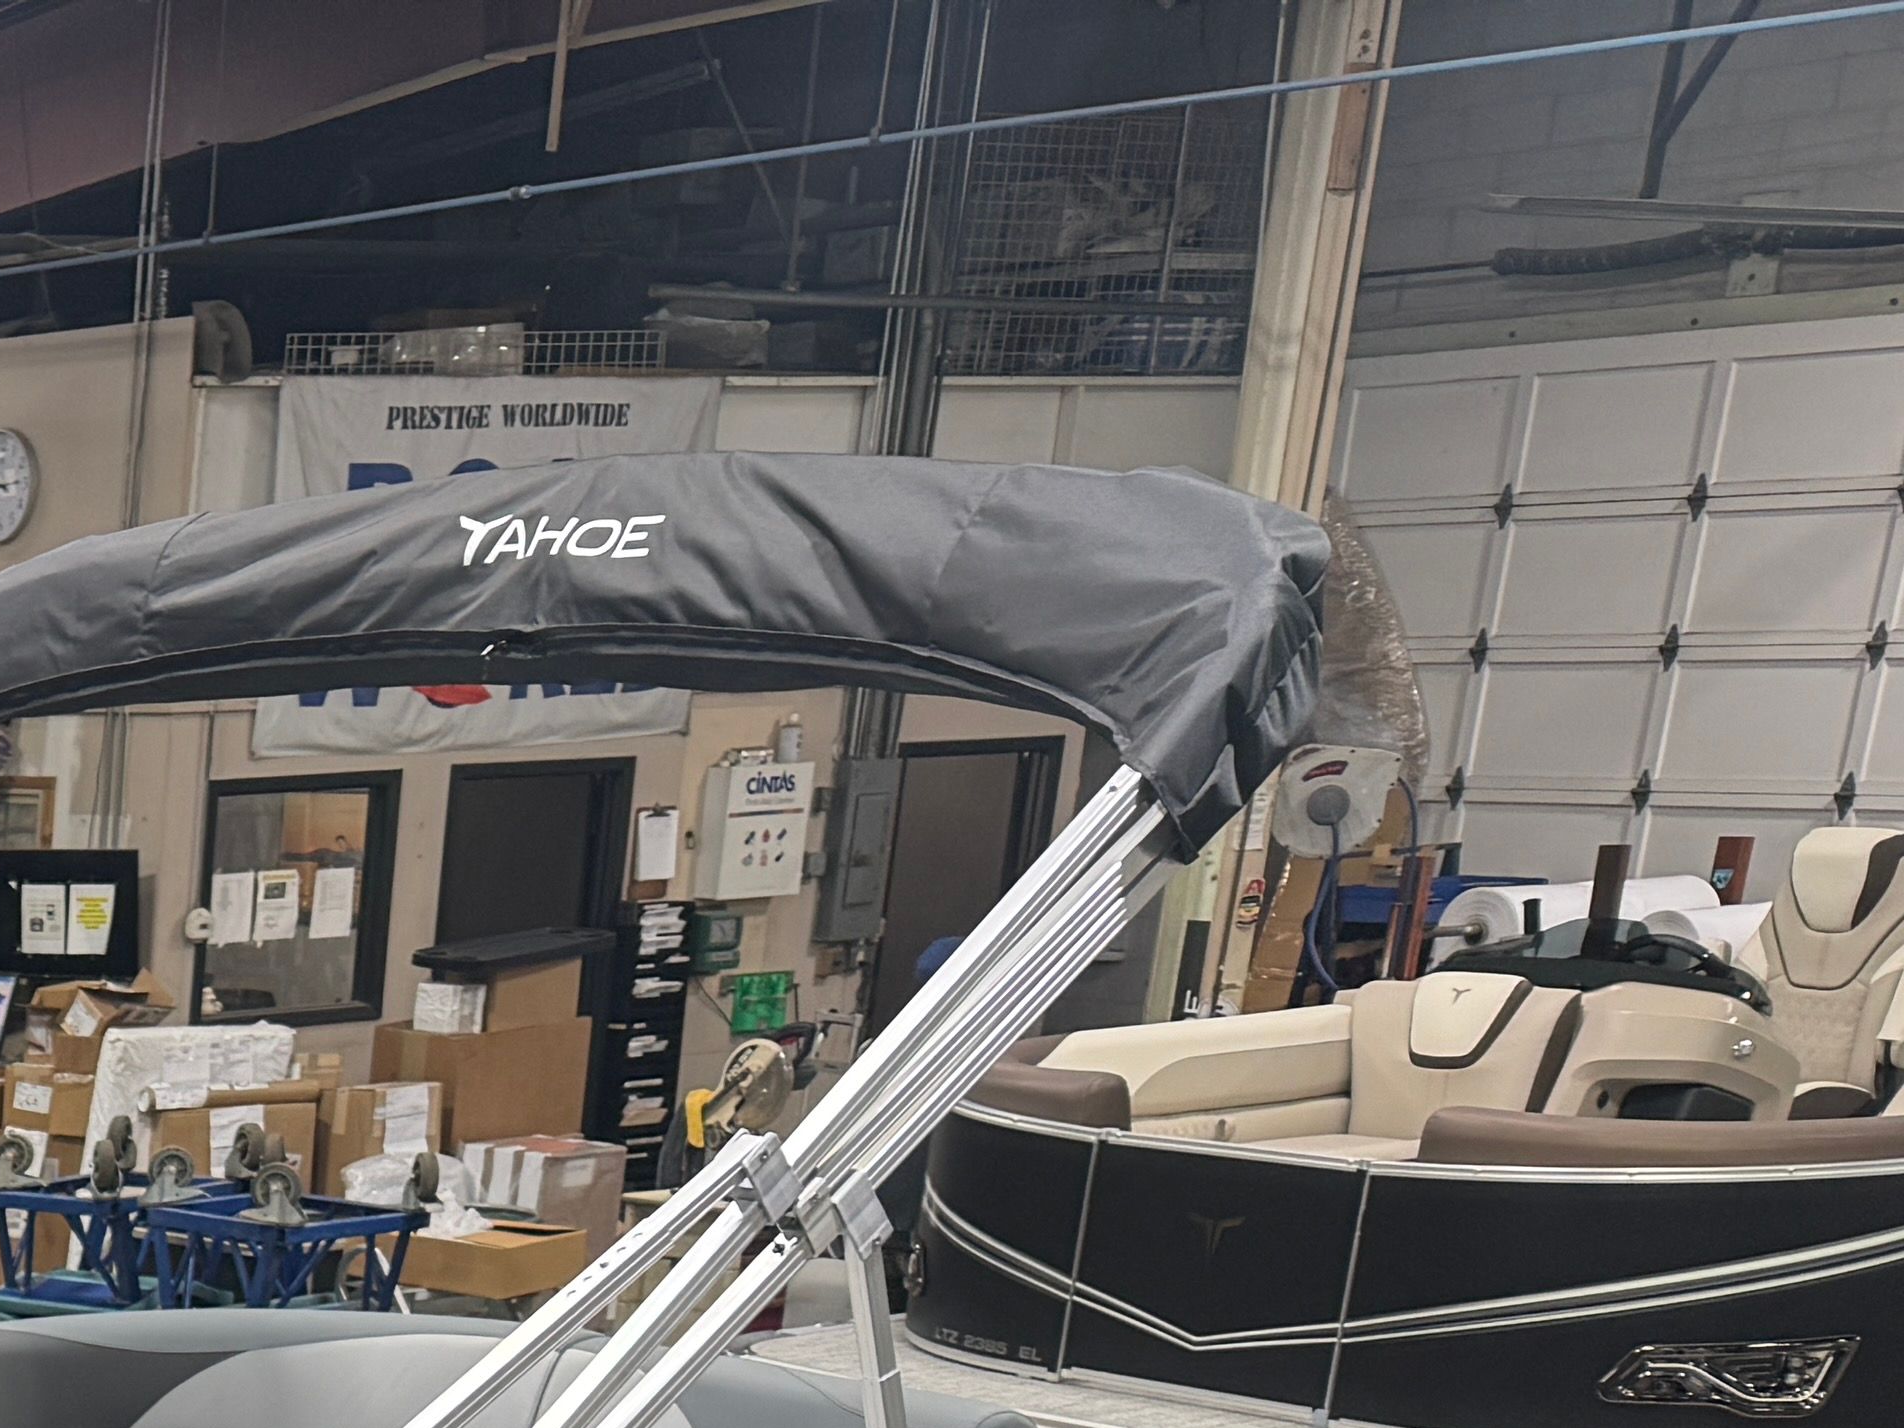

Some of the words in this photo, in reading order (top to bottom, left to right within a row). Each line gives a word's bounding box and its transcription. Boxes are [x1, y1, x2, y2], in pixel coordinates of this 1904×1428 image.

[385, 404, 491, 430] PRESTIGE
[501, 402, 631, 427] WORLDWIDE
[459, 513, 666, 567] TAHOE
